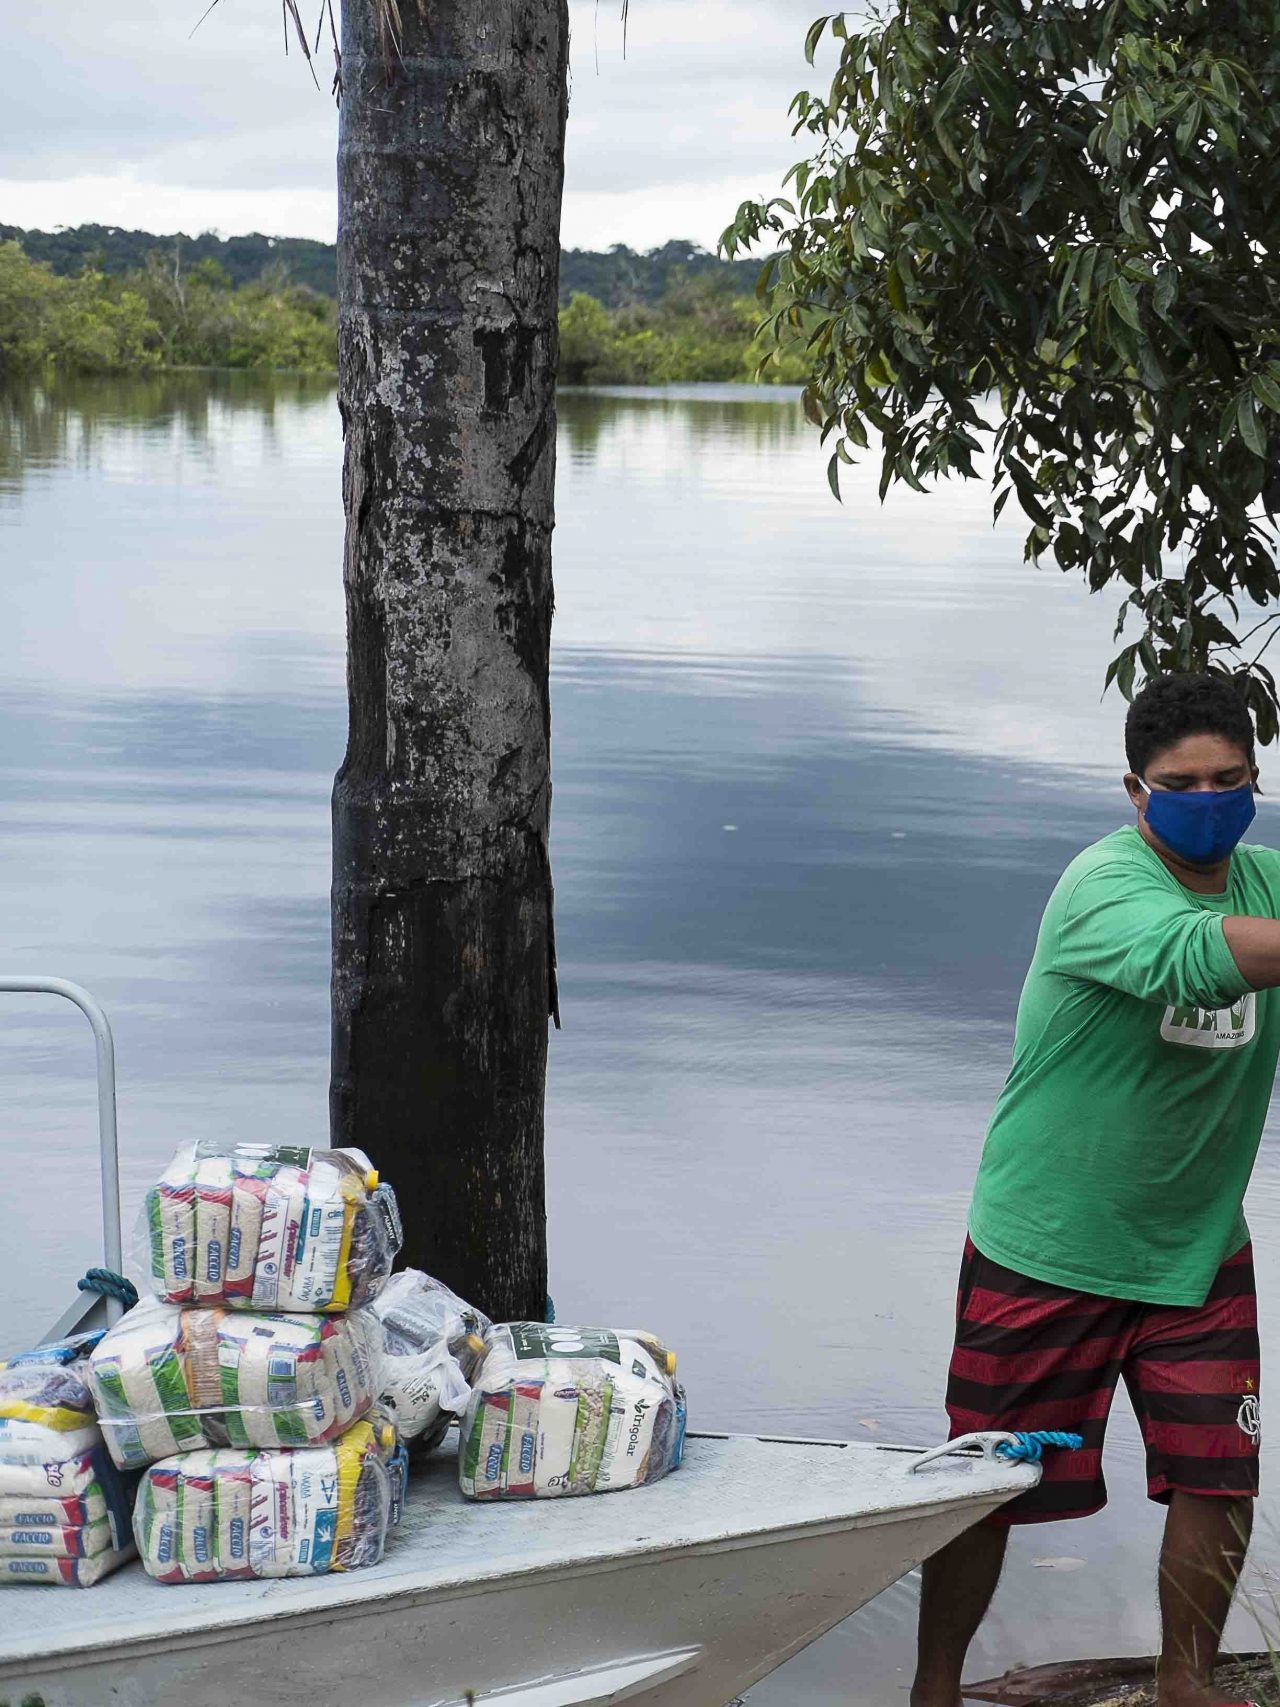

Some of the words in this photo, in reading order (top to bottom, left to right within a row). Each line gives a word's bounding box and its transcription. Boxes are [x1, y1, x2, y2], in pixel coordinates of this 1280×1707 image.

[384, 1215, 395, 1239] ALBANY
[173, 1239, 186, 1279] FACCIO
[208, 1243, 220, 1280] FACCIO
[229, 1231, 241, 1268] FACCIO
[627, 1413, 645, 1457] Trigolar
[487, 1444, 501, 1480] FACCIO
[521, 1436, 533, 1472] FACCIO
[18, 1514, 54, 1523] FACCIO
[15, 1532, 49, 1543] FACCIO
[159, 1525, 172, 1562] FACCIO
[195, 1528, 206, 1561] FACCIO
[231, 1520, 242, 1557] FACCIO
[12, 1562, 45, 1572] FACCIO
